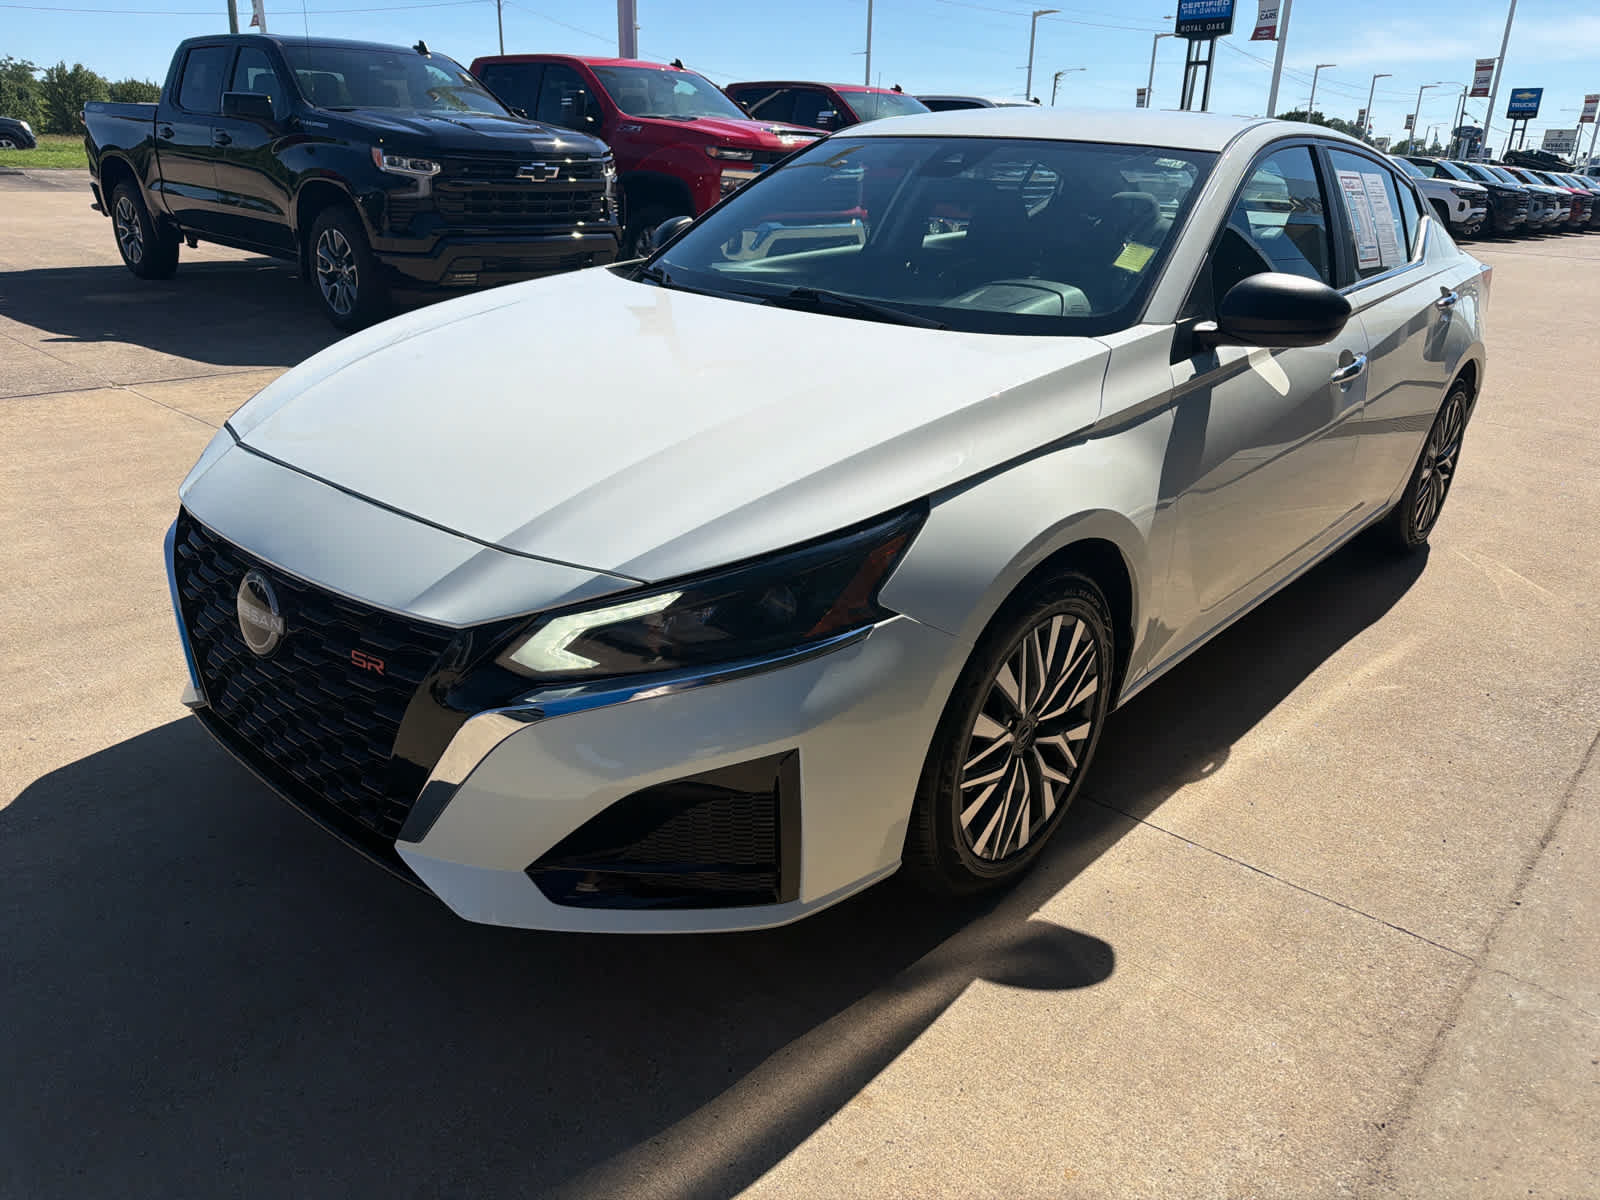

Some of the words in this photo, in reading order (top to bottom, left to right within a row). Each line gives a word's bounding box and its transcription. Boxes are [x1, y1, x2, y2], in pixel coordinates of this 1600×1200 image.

[1181, 0, 1230, 9] CERTIFIED
[1260, 12, 1277, 20] CARS
[1181, 24, 1203, 33] ROYAL
[1206, 22, 1225, 31] OAKS
[351, 649, 385, 676] SR
